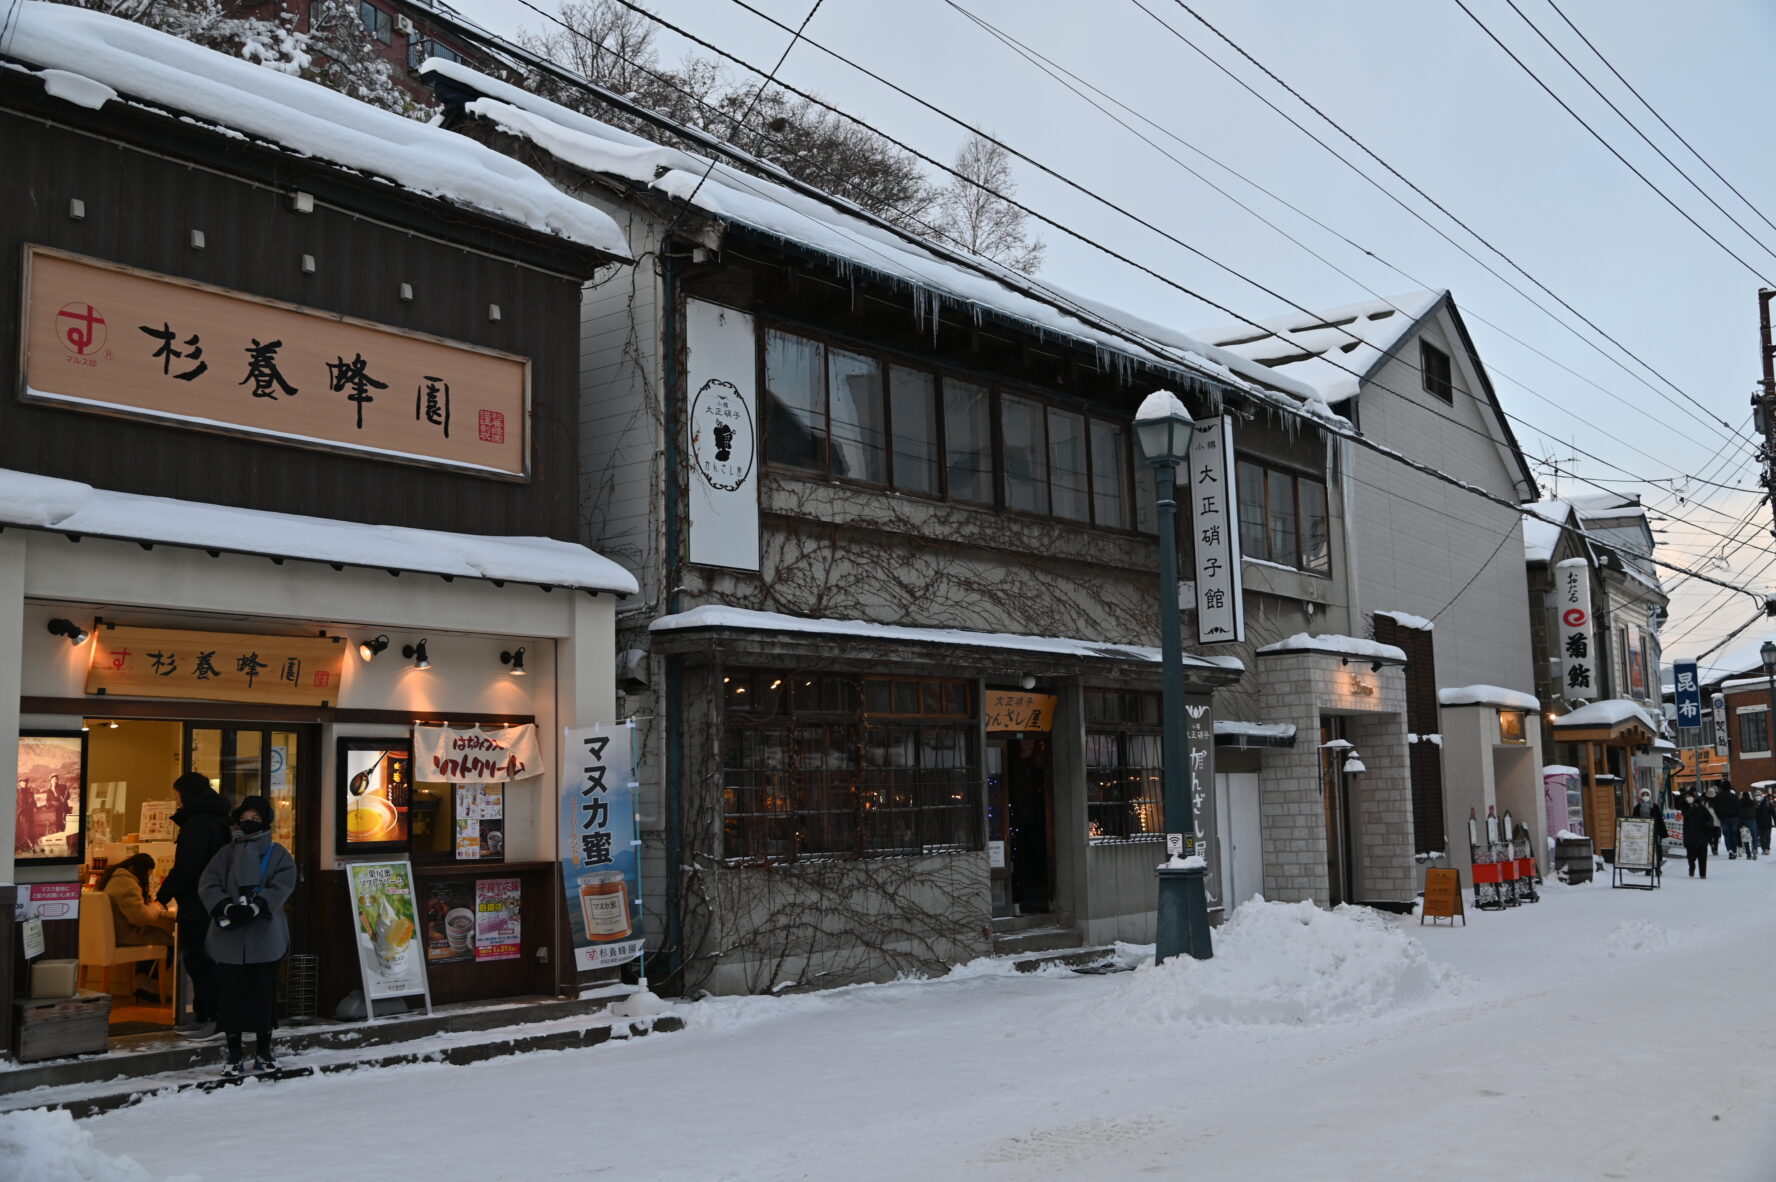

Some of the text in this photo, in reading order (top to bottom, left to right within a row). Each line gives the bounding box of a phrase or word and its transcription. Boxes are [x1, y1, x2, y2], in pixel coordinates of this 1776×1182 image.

[138, 321, 451, 438] 杉養蜂園
[1198, 463, 1225, 610] 大正硝子館
[1567, 571, 1579, 603] おたる
[146, 650, 302, 688] 杉養蜂園
[1566, 632, 1590, 689] 菊鮨
[1676, 671, 1699, 719] 昆布
[581, 736, 614, 867] マヌカ蜜
[600, 943, 637, 958] 杉養蜂園
